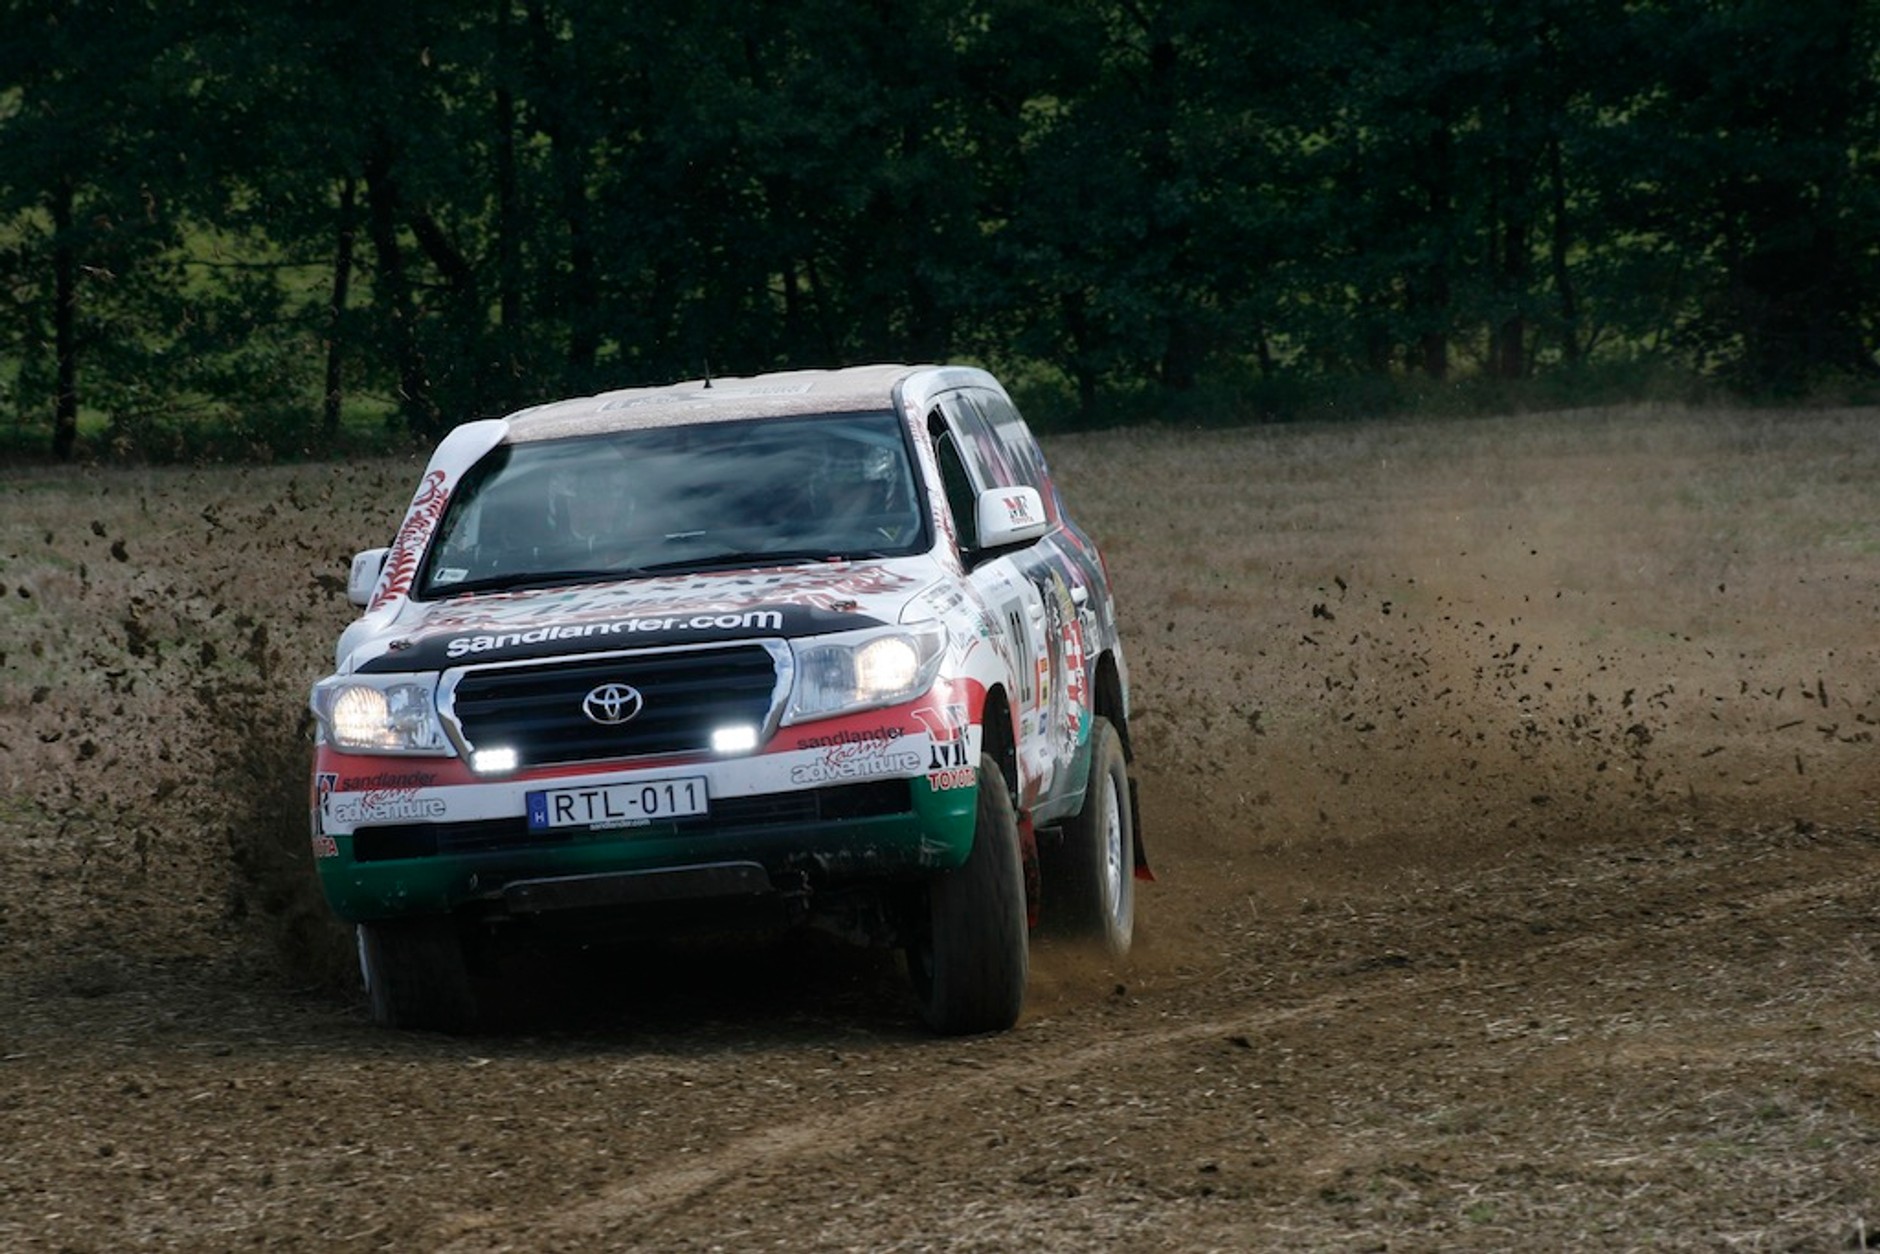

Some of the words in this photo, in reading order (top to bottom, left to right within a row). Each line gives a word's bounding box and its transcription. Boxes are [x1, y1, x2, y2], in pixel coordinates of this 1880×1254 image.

[446, 610, 783, 658] sandlander.com
[796, 725, 905, 750] sandlander
[790, 749, 921, 785] adventure
[341, 771, 437, 790] sandlander
[335, 798, 446, 823] adventure
[555, 783, 696, 822] RTL-011
[534, 811, 545, 823] H
